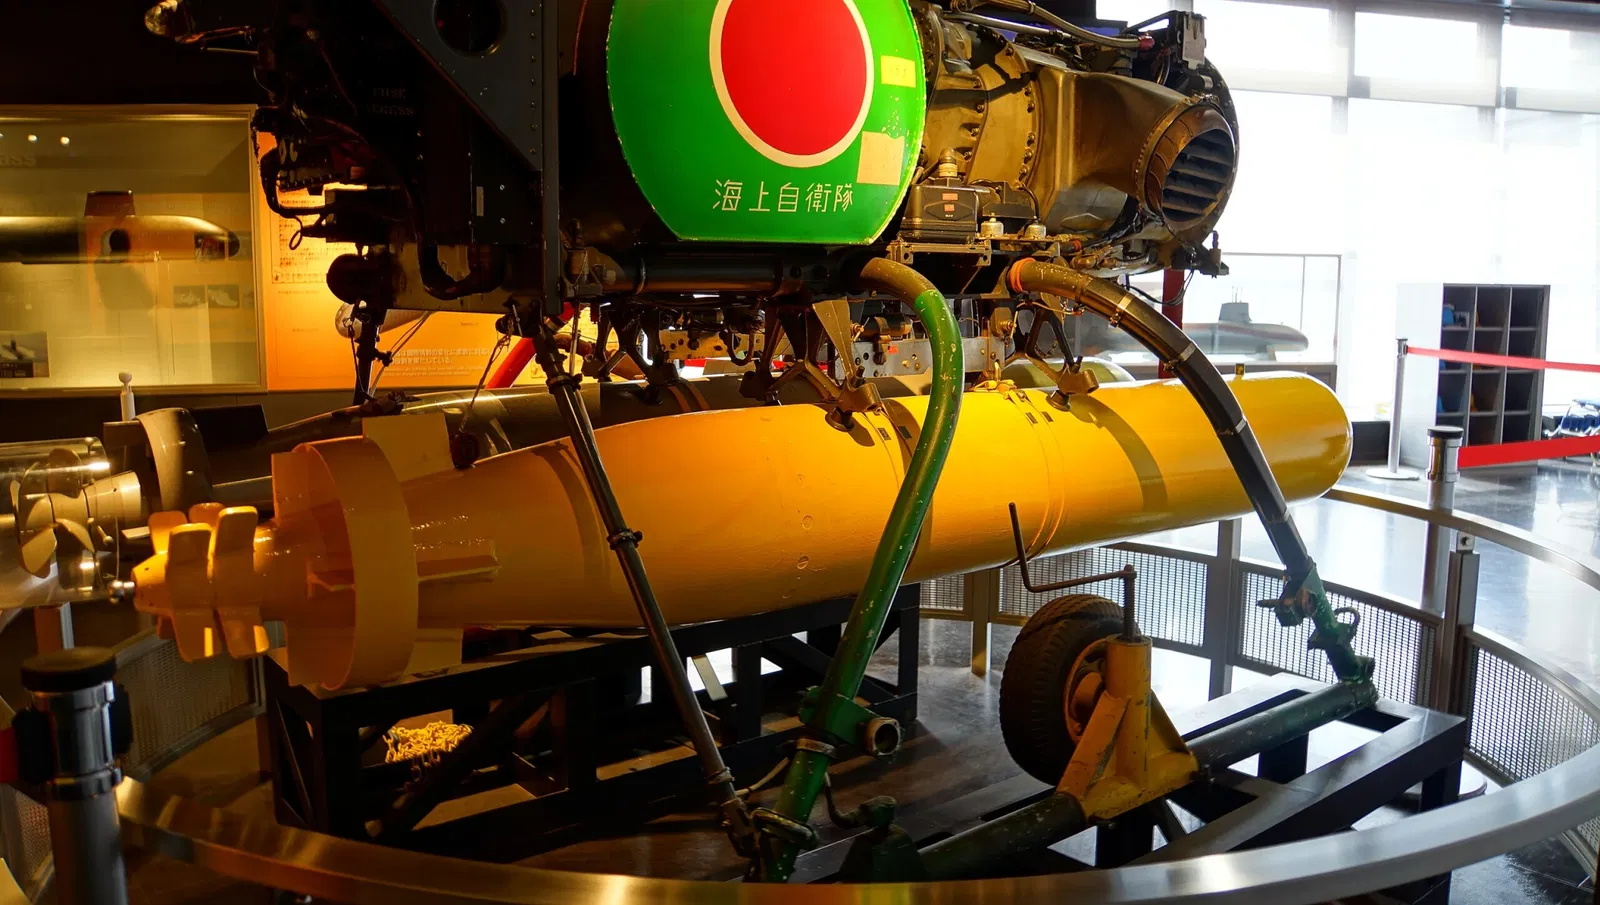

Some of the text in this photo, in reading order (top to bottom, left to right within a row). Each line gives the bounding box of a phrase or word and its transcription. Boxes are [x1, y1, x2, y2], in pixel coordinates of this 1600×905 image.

[712, 179, 854, 213] 海上自衛隊
